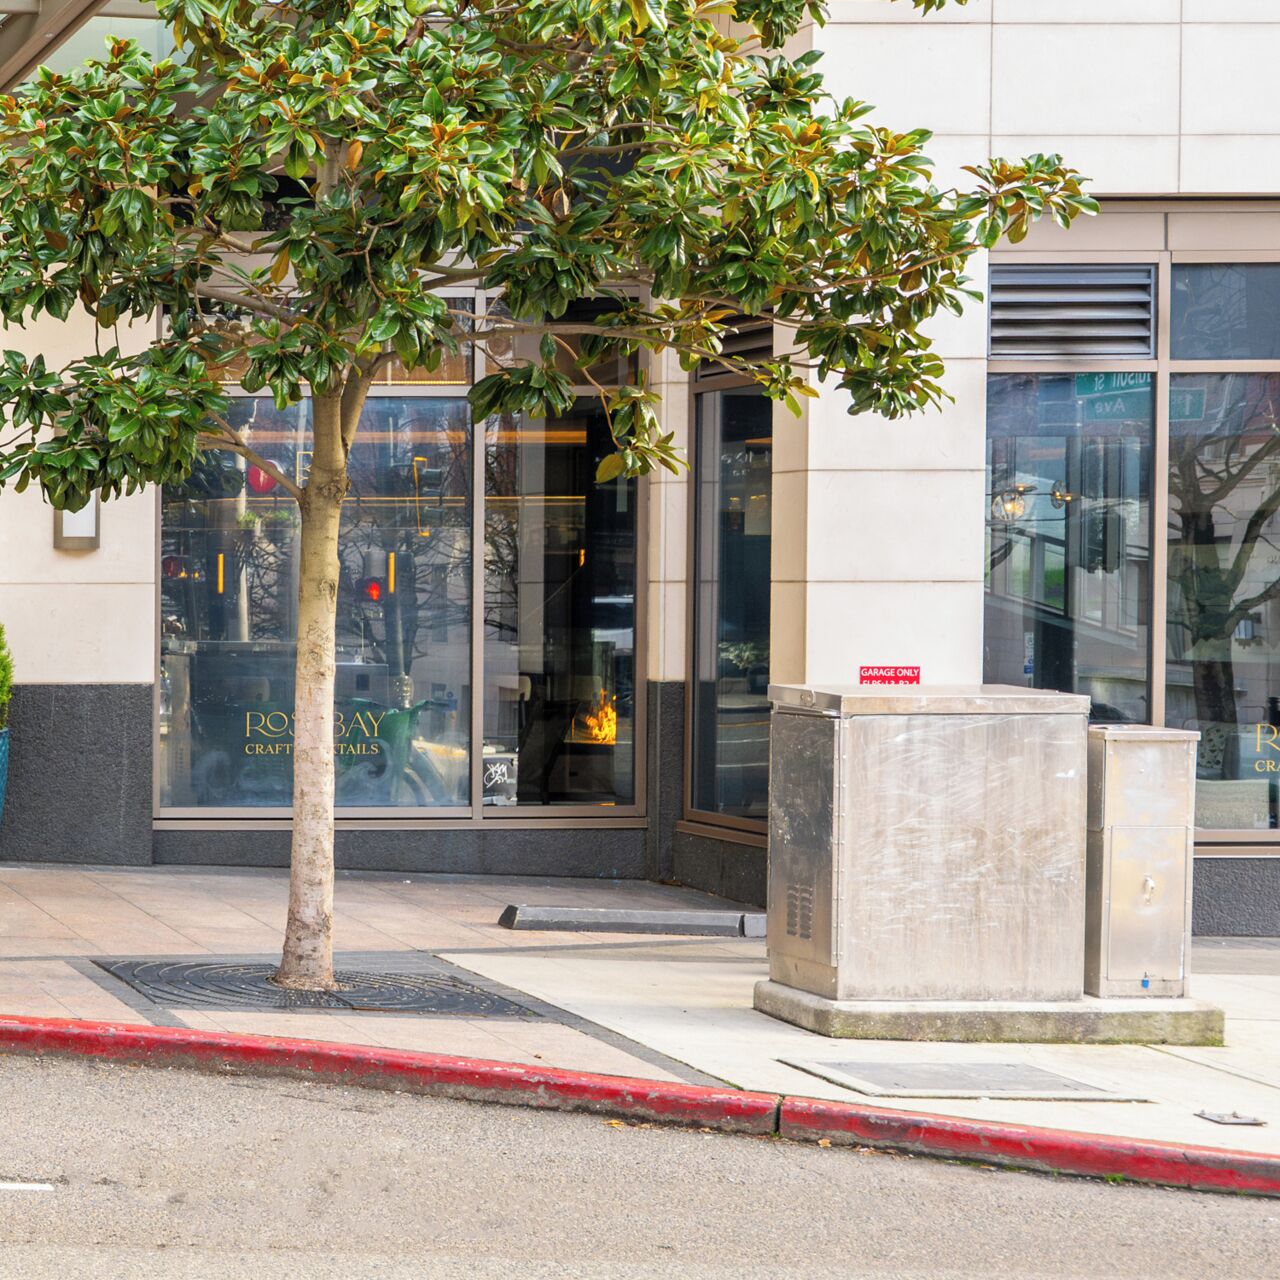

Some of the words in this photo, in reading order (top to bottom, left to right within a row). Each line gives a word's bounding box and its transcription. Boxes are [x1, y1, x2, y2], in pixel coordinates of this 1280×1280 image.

[861, 668, 895, 677] GARAGE
[896, 668, 919, 677] ONLY
[244, 743, 292, 755] CRAFT
